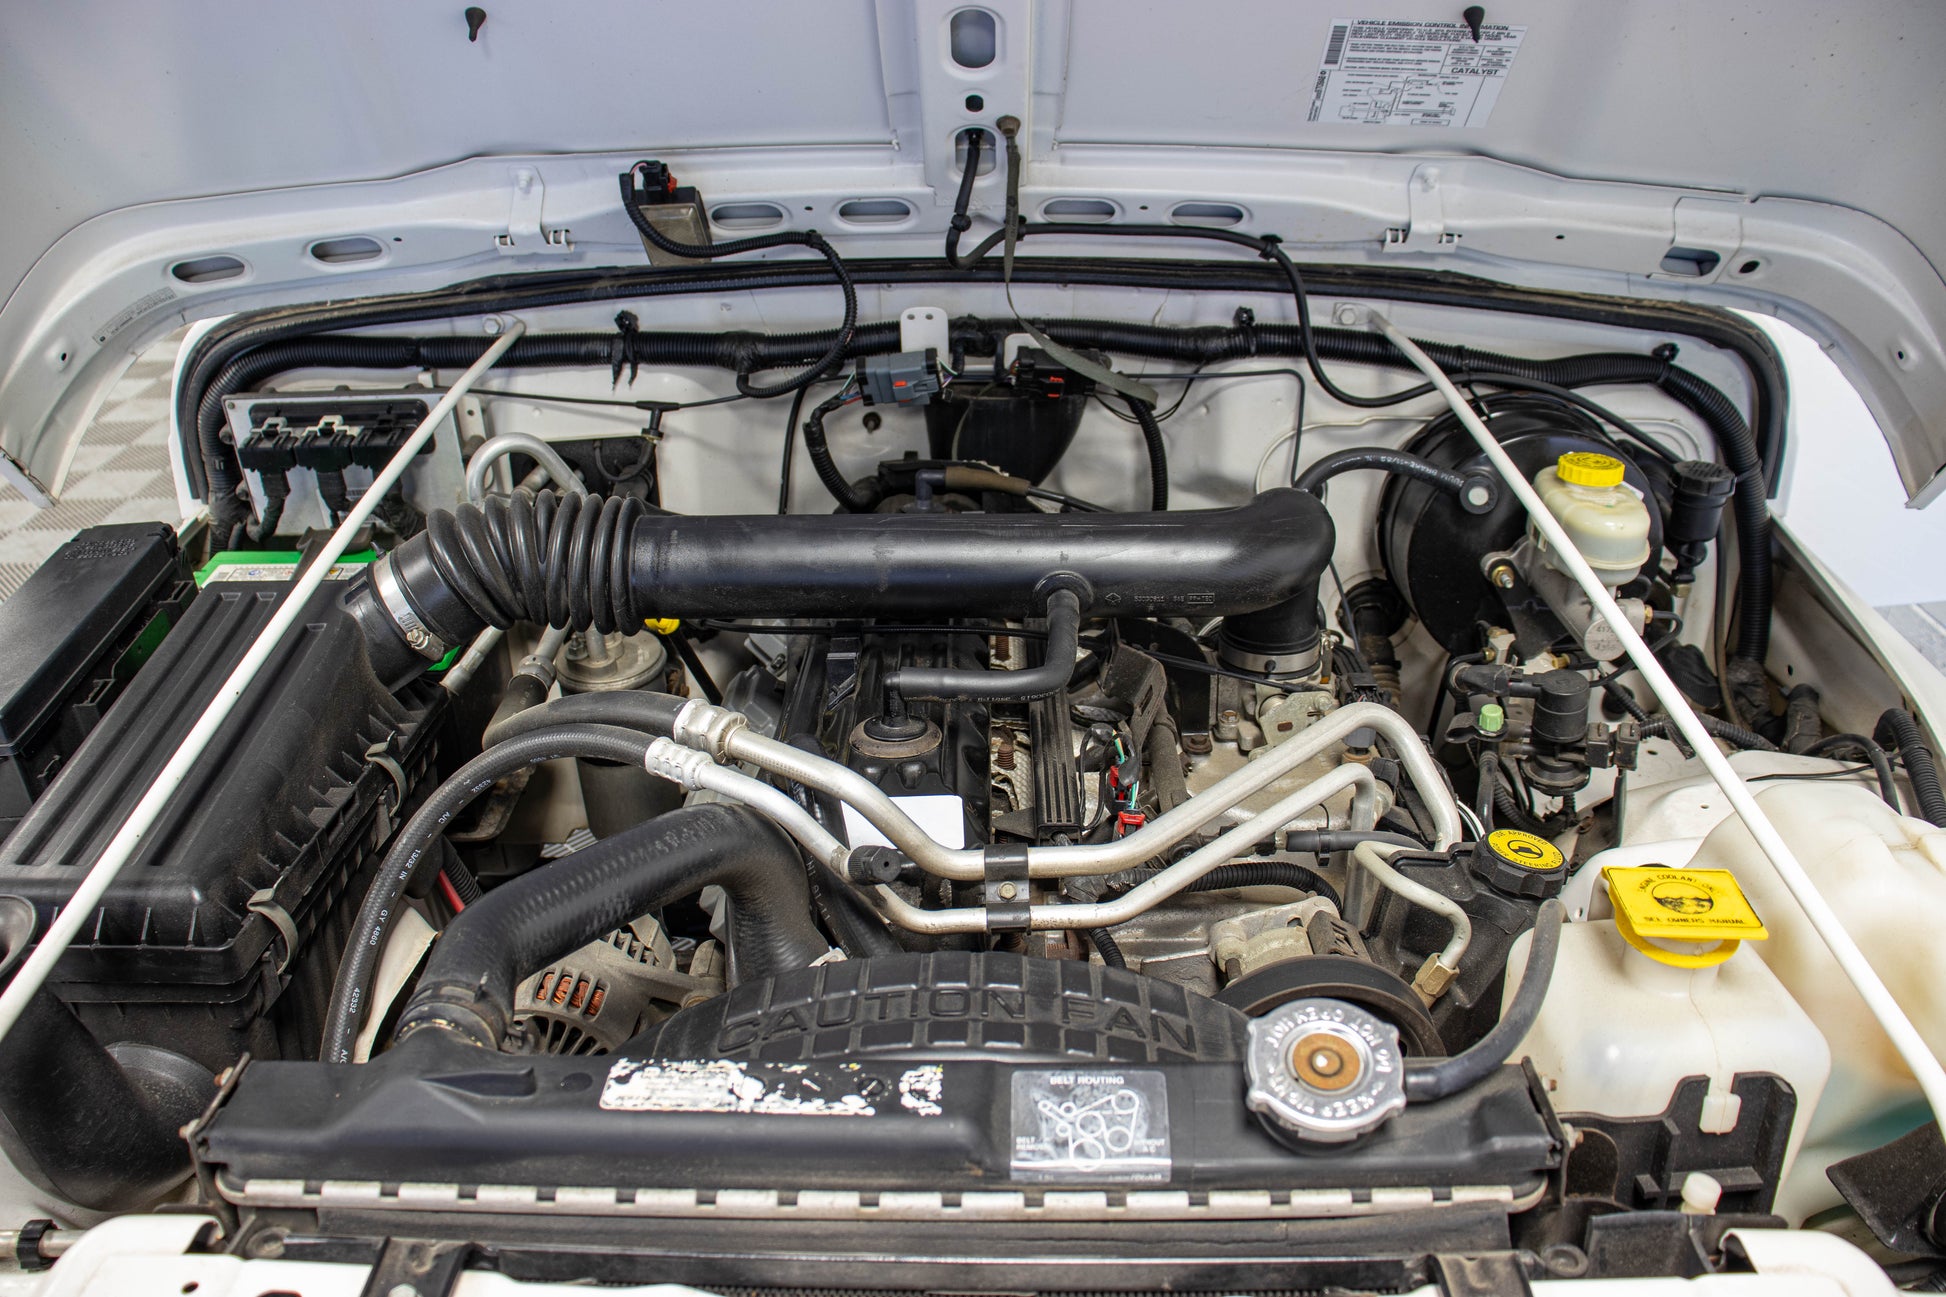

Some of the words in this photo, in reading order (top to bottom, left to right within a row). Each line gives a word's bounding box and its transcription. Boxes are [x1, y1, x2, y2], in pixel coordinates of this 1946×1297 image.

[1387, 20, 1423, 28] EMISSION
[1459, 23, 1510, 31] INMATION
[1451, 67, 1500, 76] CATALYST
[438, 811, 451, 825] A/C
[1508, 830, 1548, 845] APPROVED
[405, 848, 422, 870] 13/32
[1513, 858, 1554, 868] STEERING
[398, 869, 407, 881] IN
[380, 909, 389, 924] GY
[369, 926, 381, 946] 4860
[349, 987, 360, 1015] 42332
[716, 988, 1026, 1053] CAUTION
[1062, 994, 1196, 1052] FAN
[1050, 1076, 1076, 1085] BELT
[1077, 1076, 1125, 1085] ROUTING
